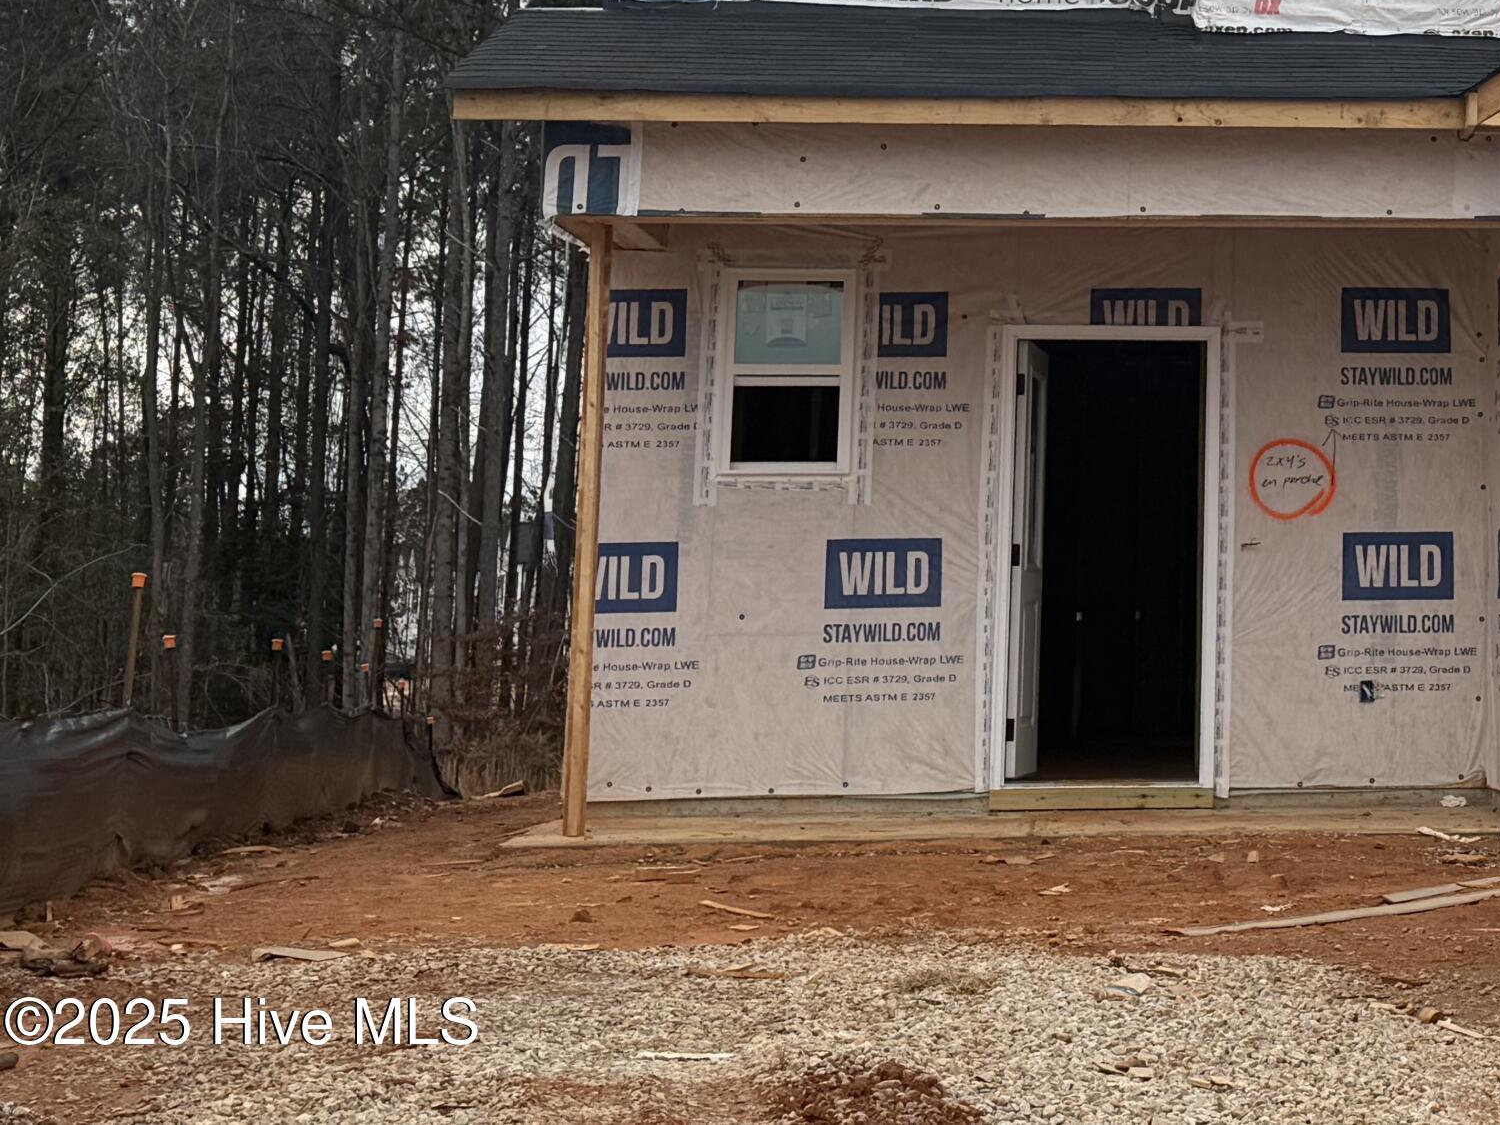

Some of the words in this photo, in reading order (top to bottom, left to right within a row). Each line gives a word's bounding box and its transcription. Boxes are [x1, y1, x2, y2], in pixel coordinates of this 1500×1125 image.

[1354, 299, 1439, 341] WILD
[1341, 367, 1452, 385] STAYWILD.COM
[946, 403, 969, 412] LWE
[1337, 399, 1383, 409] Grip-Rite
[1387, 399, 1449, 409] House-Wrap
[1453, 399, 1476, 407] LWE
[613, 405, 680, 414] House-Wrap
[1365, 417, 1386, 425] ESR
[1428, 417, 1459, 425] Grade
[657, 422, 688, 431] Grade
[1343, 433, 1380, 441] MEETS
[1383, 433, 1414, 441] ASTM
[1417, 433, 1423, 441] E
[656, 440, 680, 448] 2357
[1355, 544, 1441, 587] WILD
[840, 551, 929, 595] WILD
[1342, 615, 1454, 634] STAYWILD.COM
[823, 622, 940, 643] STAYWILD.COM
[1338, 647, 1384, 657] Grip-Rite
[1388, 647, 1451, 657] House-Wrap
[1454, 647, 1477, 656] LWE
[818, 657, 867, 667] Grip-Rite
[871, 656, 936, 666] House-Wrap
[940, 655, 964, 664] LWE
[603, 662, 670, 672] House-Wrap
[674, 661, 700, 670] LWE
[1344, 666, 1362, 674] ICC
[1366, 666, 1387, 674] ESR
[1391, 666, 1396, 674] #
[1430, 666, 1460, 674] Grade
[1463, 666, 1471, 674] D
[647, 680, 679, 689] Grade
[683, 680, 691, 688] D
[824, 676, 843, 685] ICC
[847, 676, 870, 685] ESR
[873, 676, 879, 684] #
[914, 675, 945, 683] Grade
[949, 674, 956, 682] D
[1383, 683, 1414, 691] ASTM
[1418, 683, 1424, 691] E
[1429, 683, 1451, 691] 2357
[823, 694, 862, 703] MEETS
[865, 693, 897, 702] ASTM
[901, 693, 907, 701] E
[912, 693, 935, 701] 2357
[597, 700, 629, 708] ASTM
